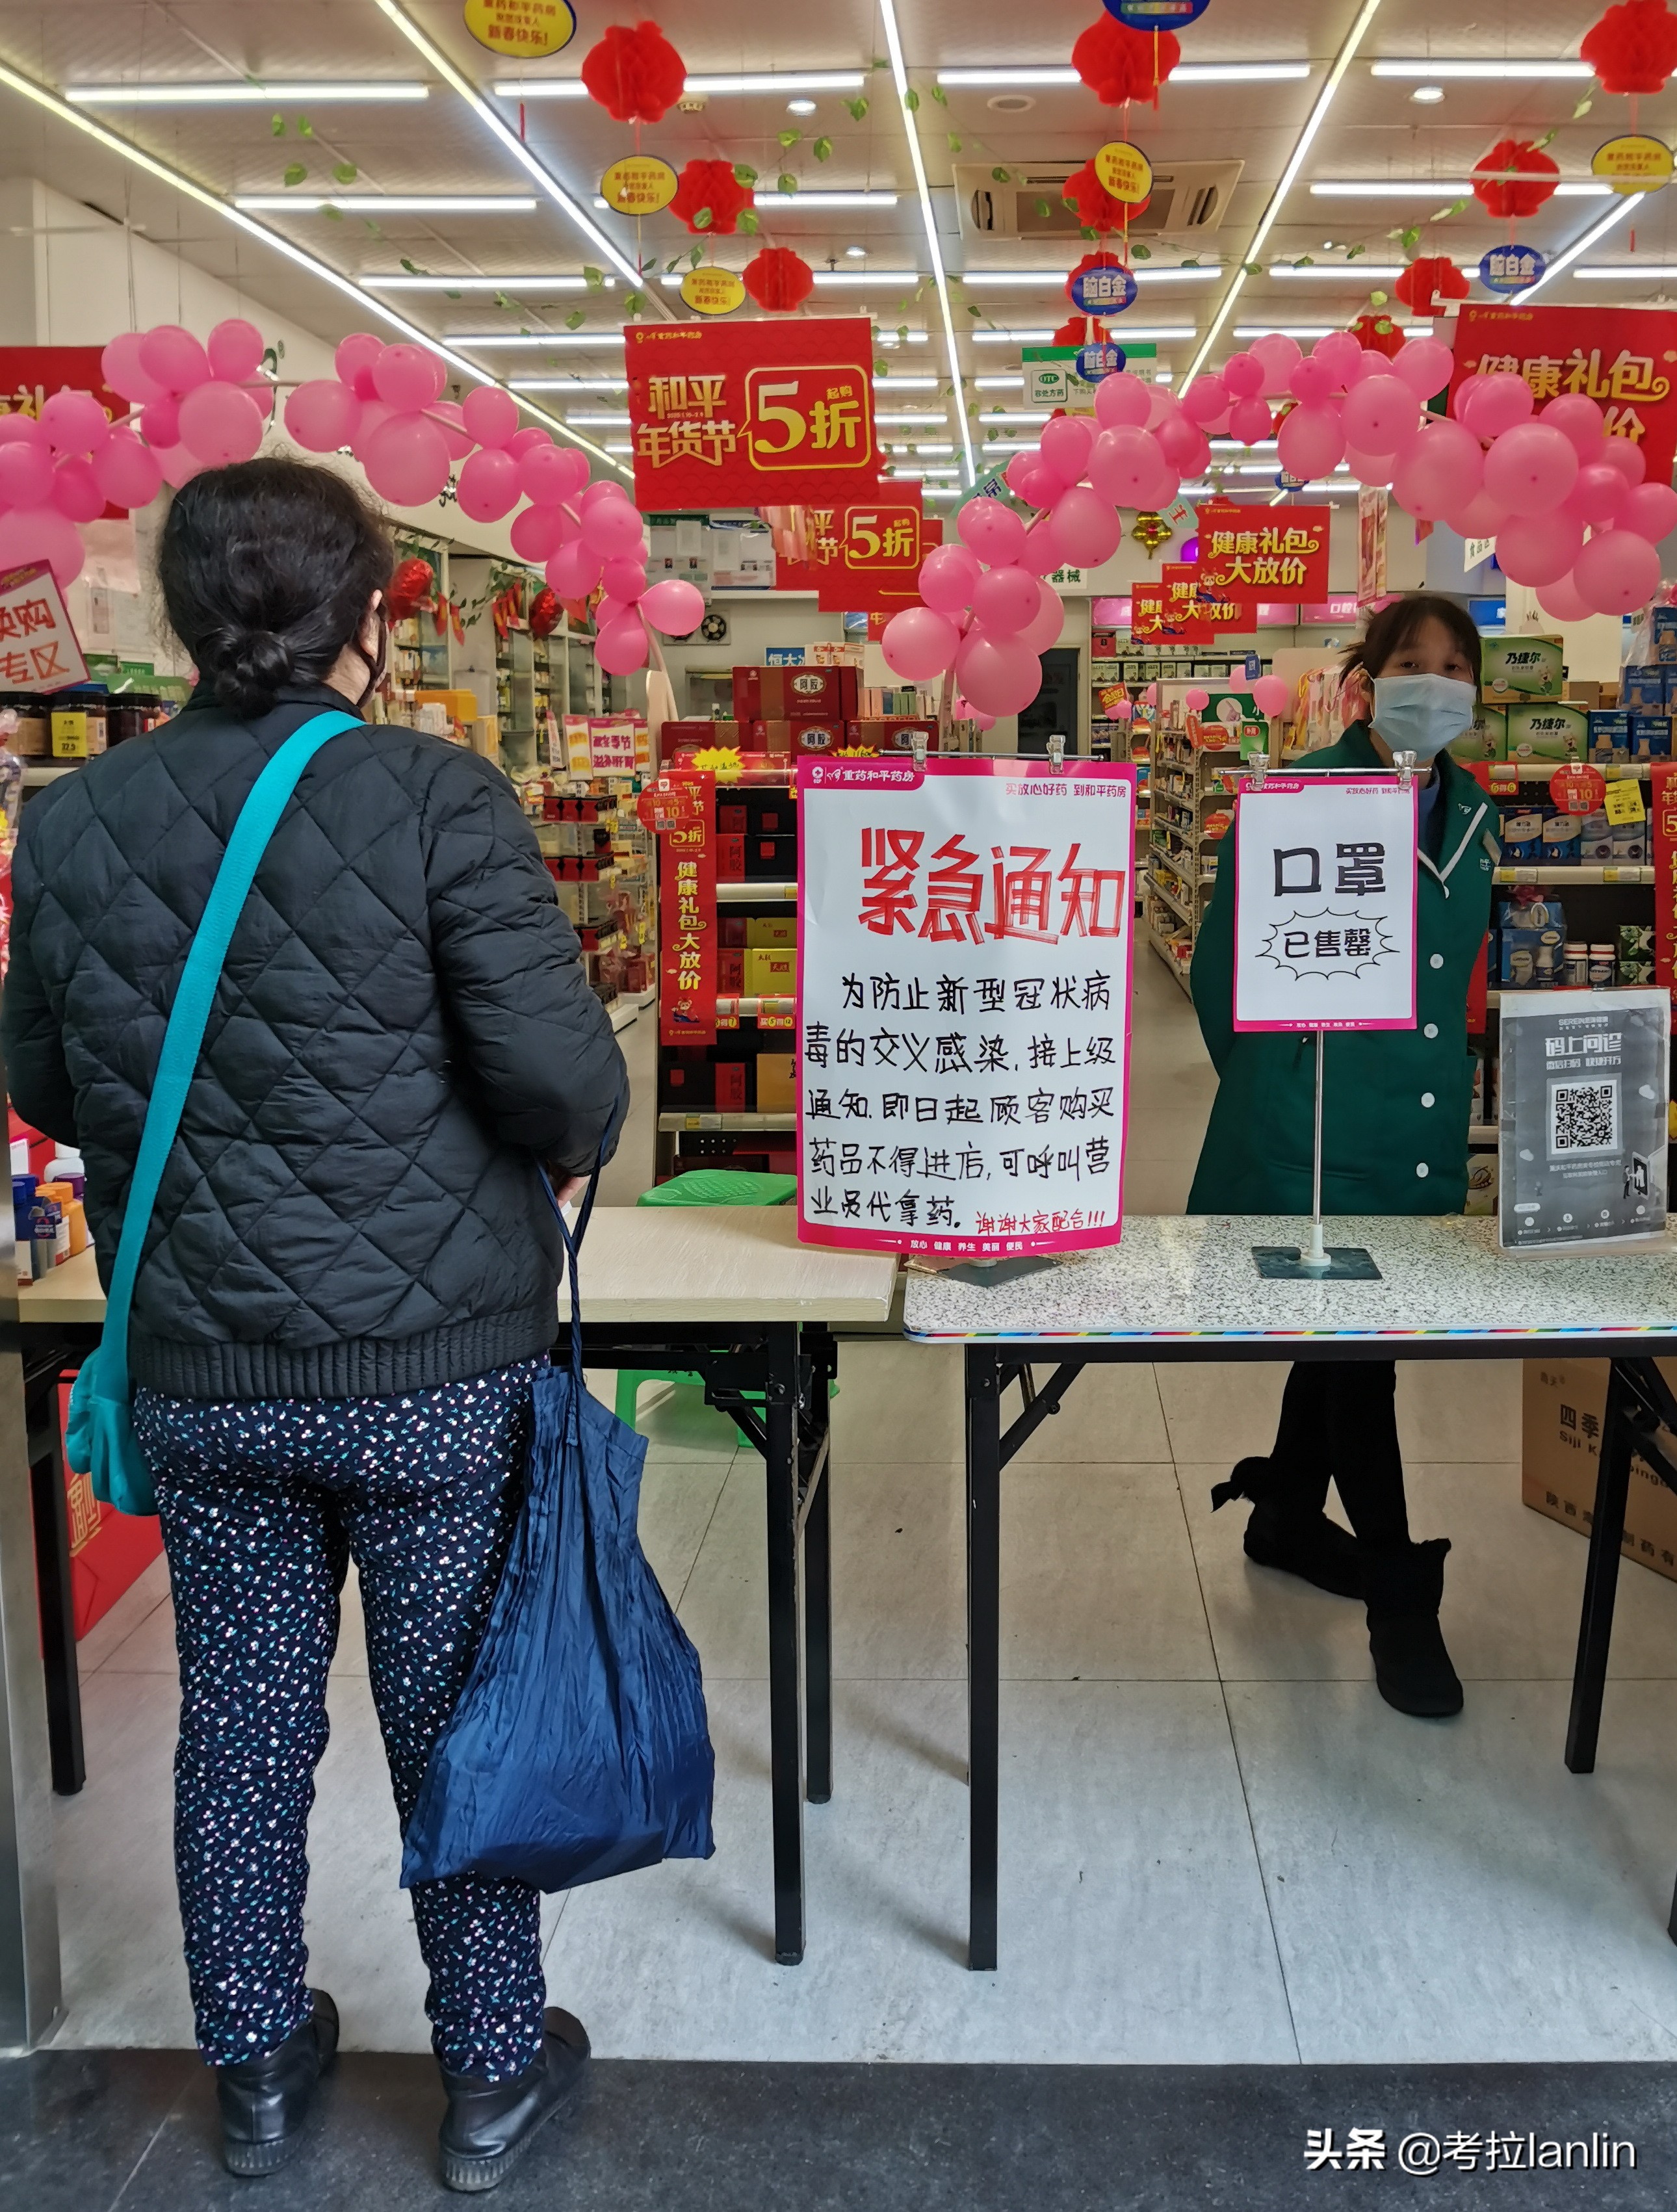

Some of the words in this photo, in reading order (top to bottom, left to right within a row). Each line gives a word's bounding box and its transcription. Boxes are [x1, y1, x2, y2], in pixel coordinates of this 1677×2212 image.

[1083, 274, 1126, 298] 脑白金
[648, 374, 727, 420] 和平
[754, 380, 862, 454] 5折
[636, 419, 737, 469] 年货节
[1207, 526, 1320, 559] 健康礼包
[1216, 555, 1308, 586] 大放价
[1505, 651, 1542, 664] 乃捷尔
[1529, 717, 1566, 731] 乃捷尔
[842, 770, 915, 783] 重药和平药房
[1005, 782, 1067, 797] 买放心好药
[1073, 783, 1126, 798] 到和平药房
[1273, 842, 1386, 897] 口罩
[857, 827, 1126, 946] 紧急通知
[672, 861, 707, 991] 健康礼包大放价
[1283, 928, 1372, 959] 已售罄
[842, 969, 1111, 1015] 为防止新型冠状病
[1545, 1032, 1622, 1058] 码上问诊
[934, 1241, 952, 1251] 健康
[957, 1242, 976, 1252] 养生
[1560, 1403, 1600, 1439] 四季
